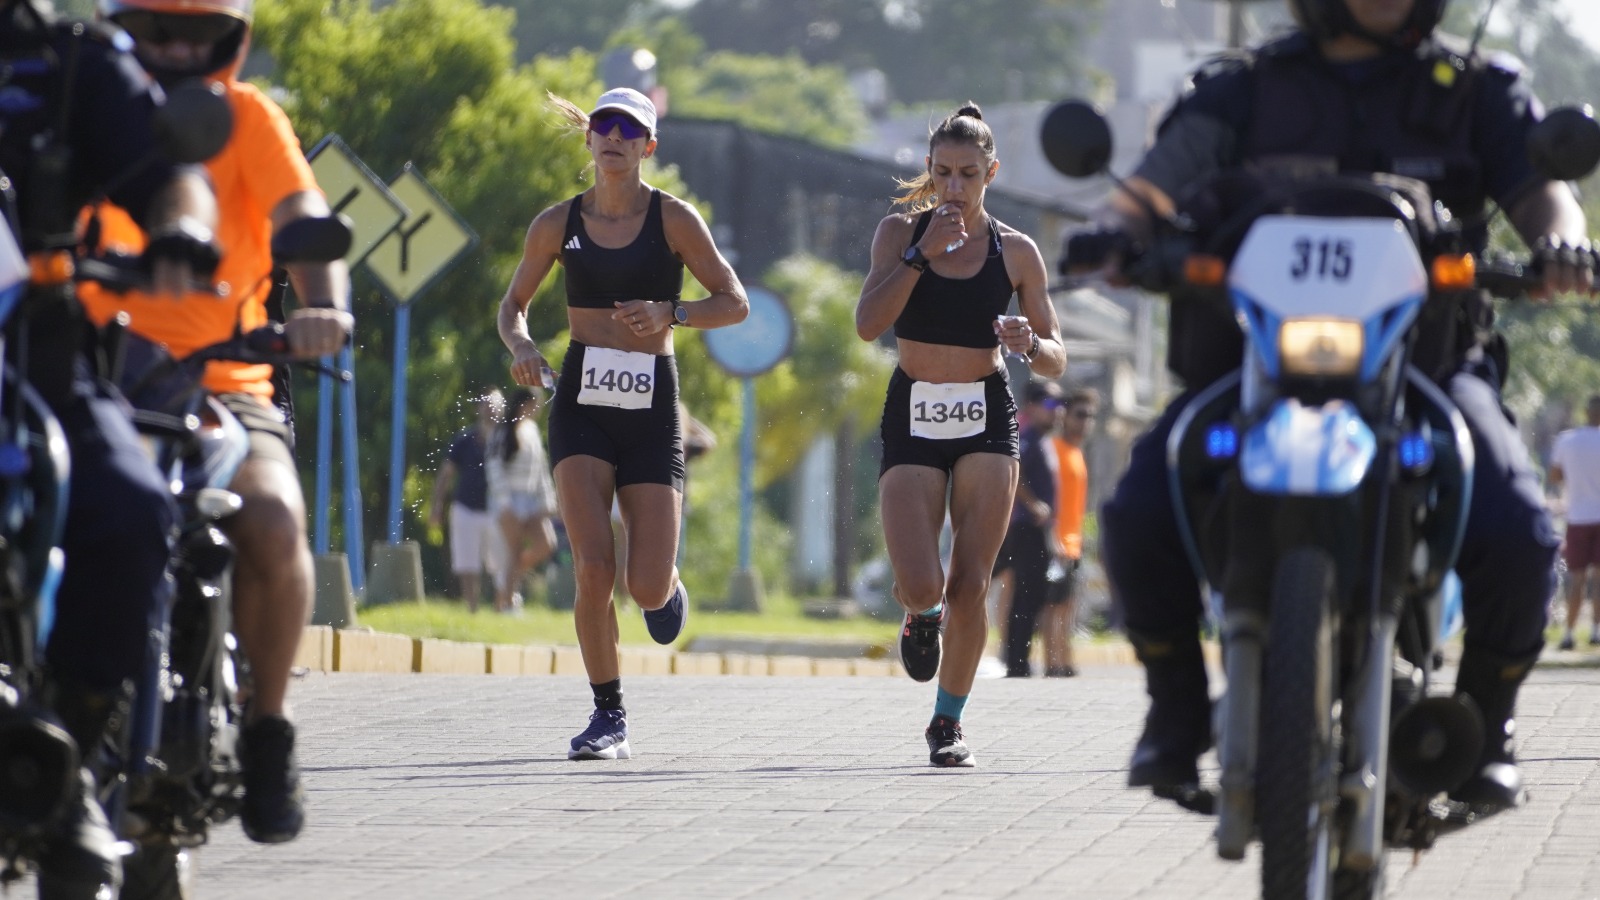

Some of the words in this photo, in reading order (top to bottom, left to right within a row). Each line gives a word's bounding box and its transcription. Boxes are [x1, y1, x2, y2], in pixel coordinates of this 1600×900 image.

[1290, 237, 1353, 281] 315
[584, 367, 652, 394] 1408
[914, 400, 985, 423] 1346
